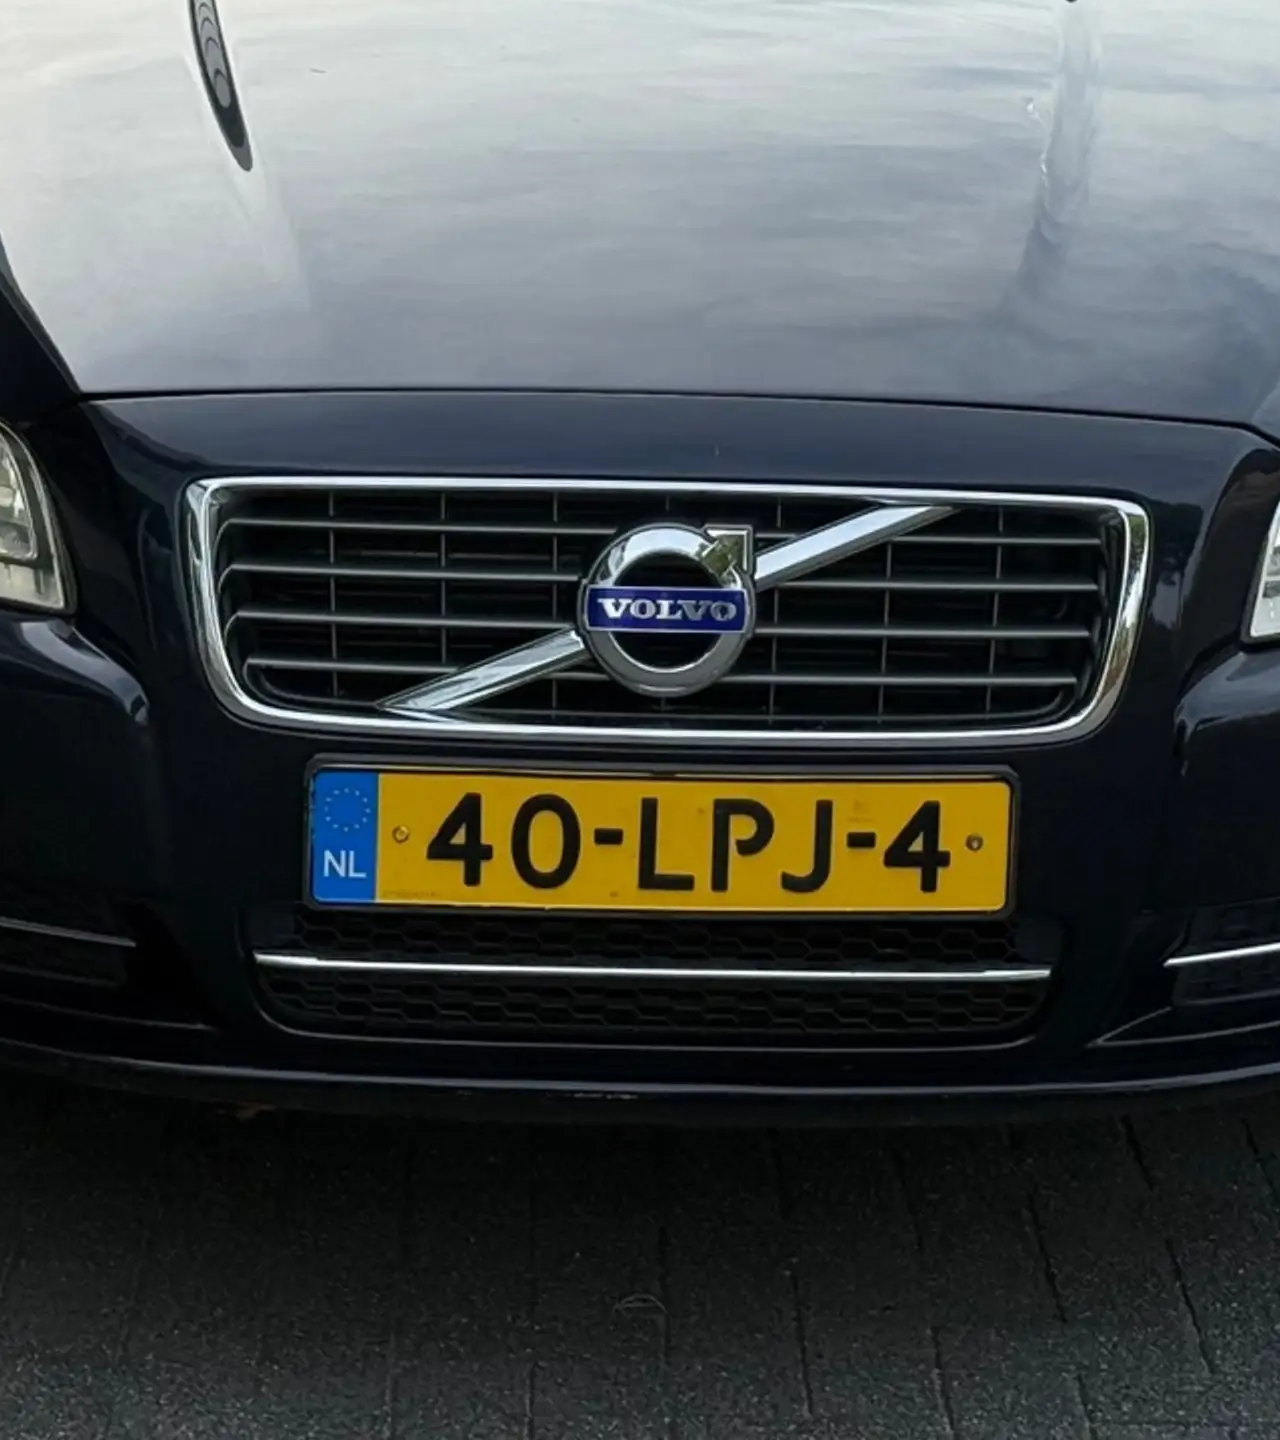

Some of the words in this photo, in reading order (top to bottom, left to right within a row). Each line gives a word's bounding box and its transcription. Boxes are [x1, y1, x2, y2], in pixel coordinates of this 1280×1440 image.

[596, 597, 738, 622] VOLVO
[426, 791, 951, 894] 40-LPJ-4
[323, 850, 368, 879] NL
